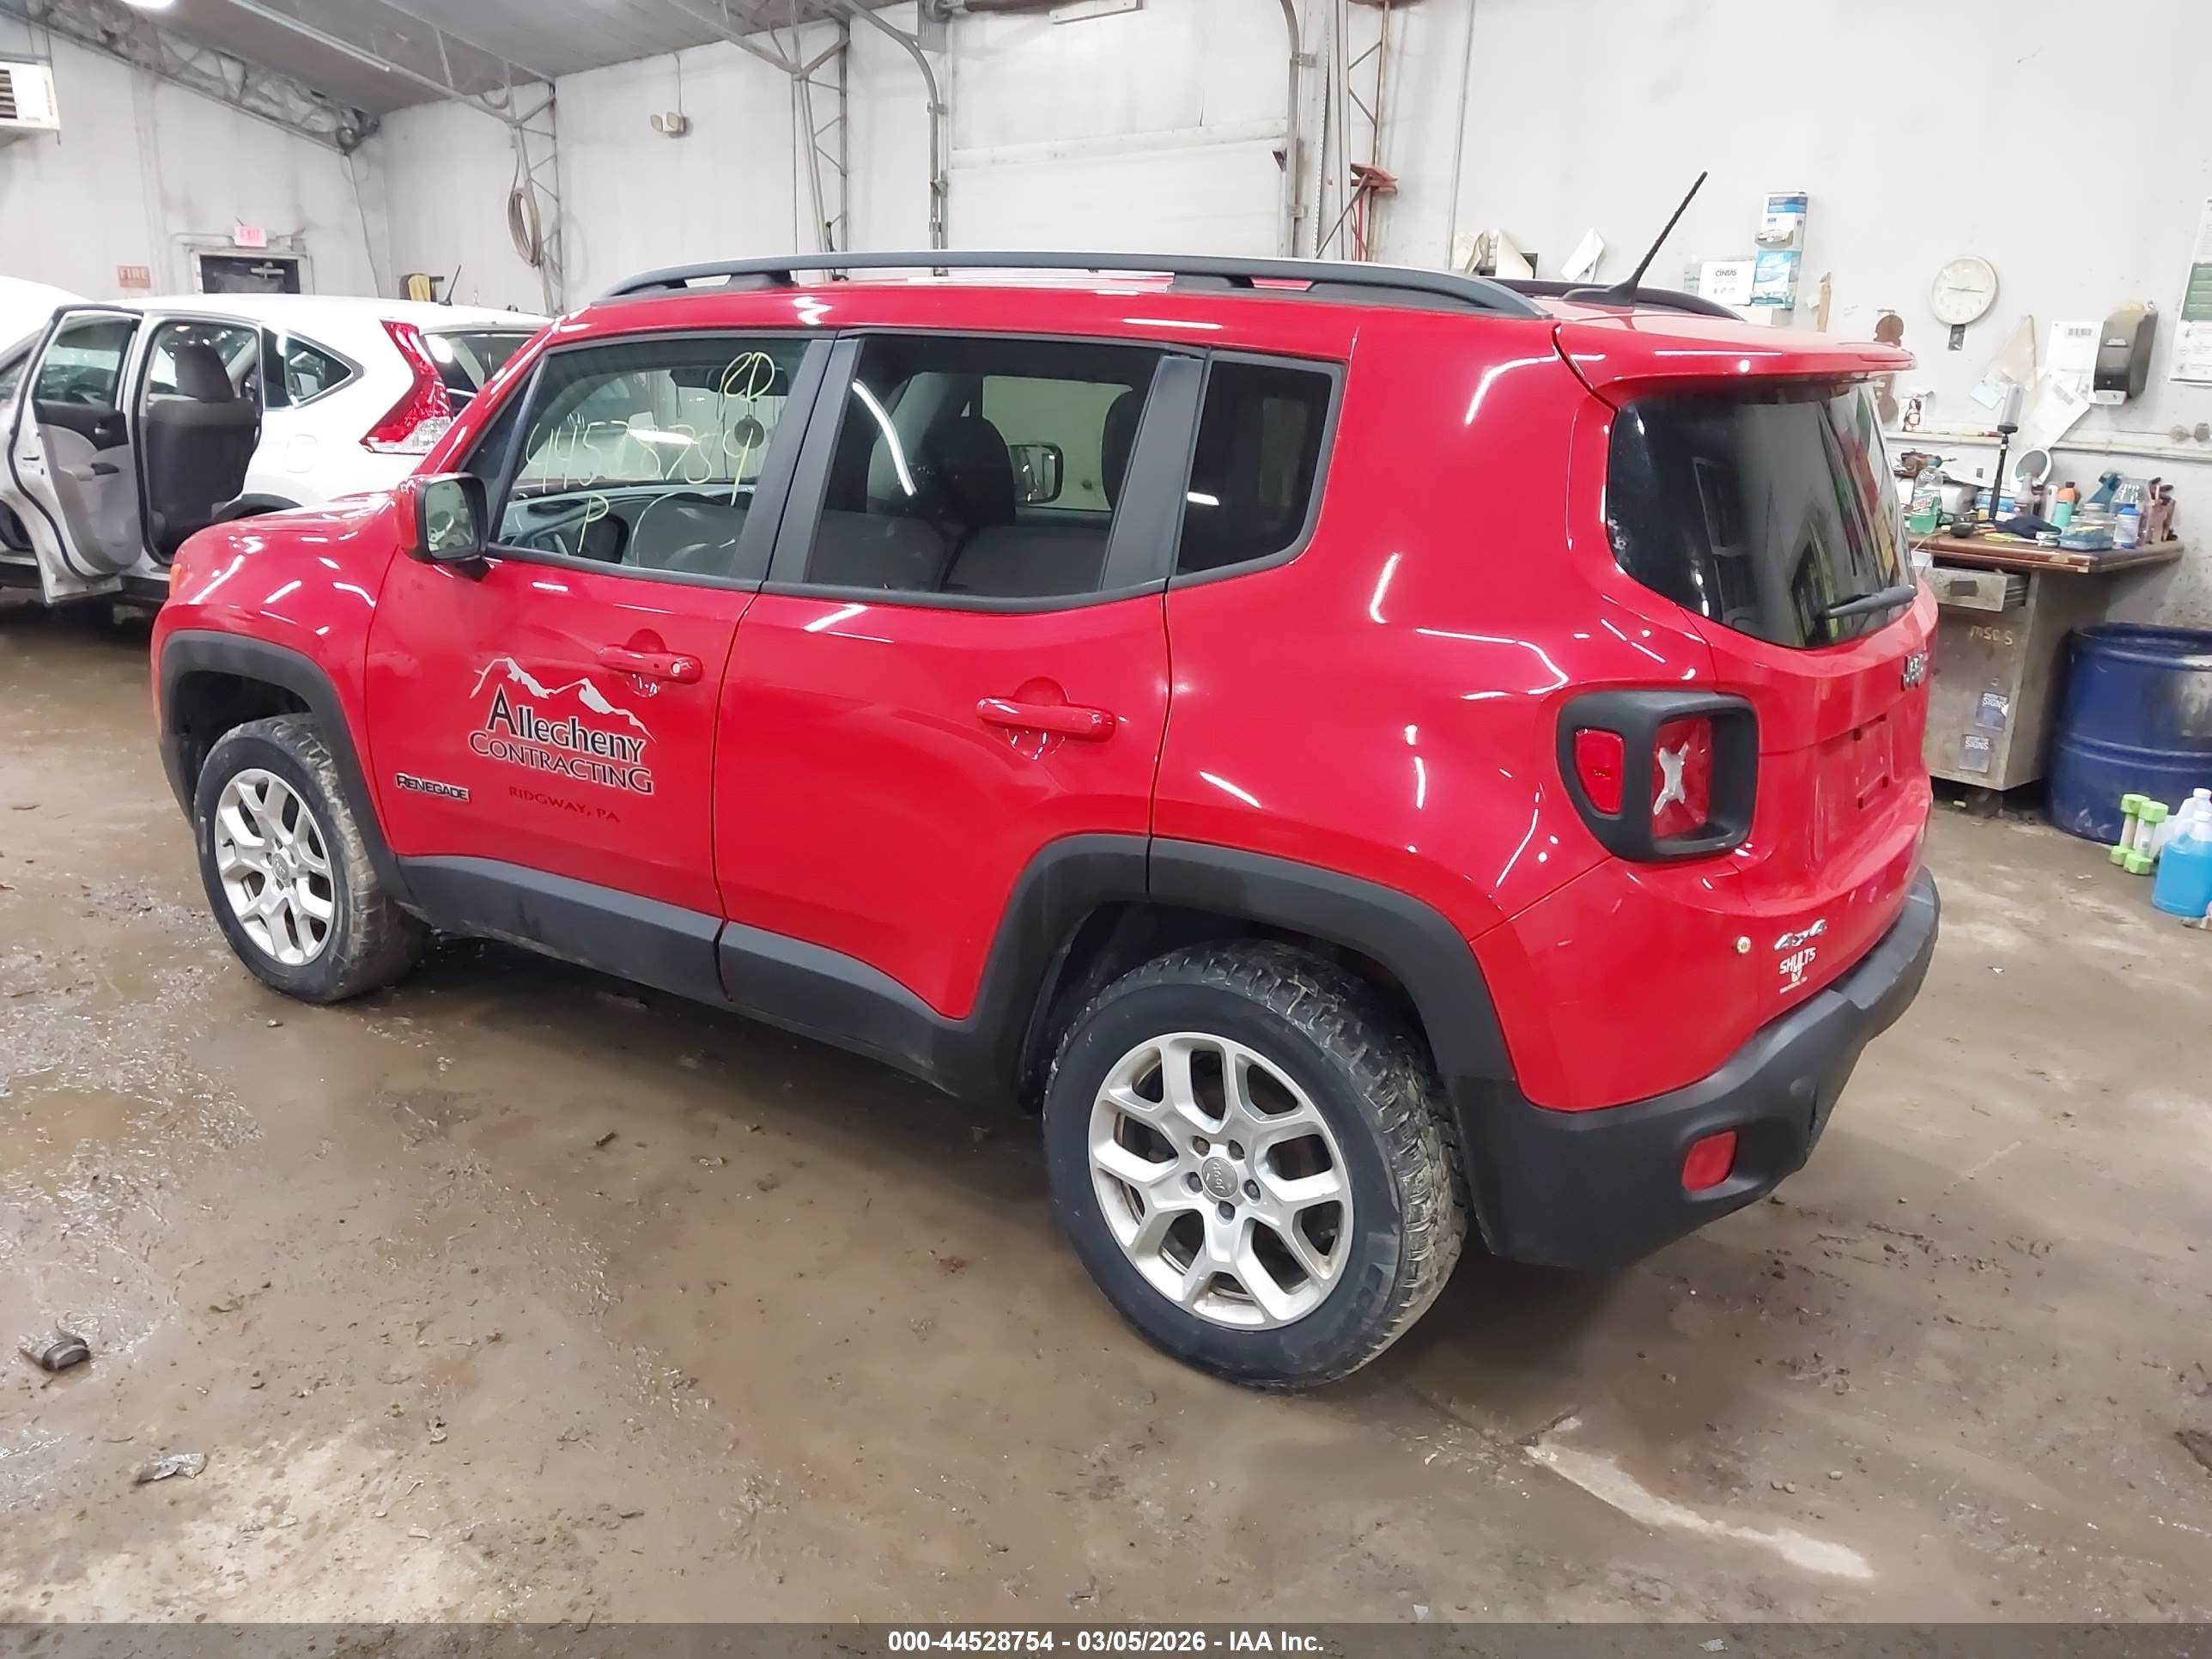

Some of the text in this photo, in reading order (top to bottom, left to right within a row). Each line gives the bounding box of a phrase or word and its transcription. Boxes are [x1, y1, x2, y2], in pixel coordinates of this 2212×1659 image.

[240, 228, 261, 241] EXIT
[120, 267, 148, 280] FIRE
[486, 684, 646, 763] Allegheny
[468, 731, 654, 797] CONTRACTING
[396, 773, 471, 802] RENEGADE
[508, 786, 621, 822] RIDGWAY, PA
[1778, 947, 1817, 975] SHULTS
